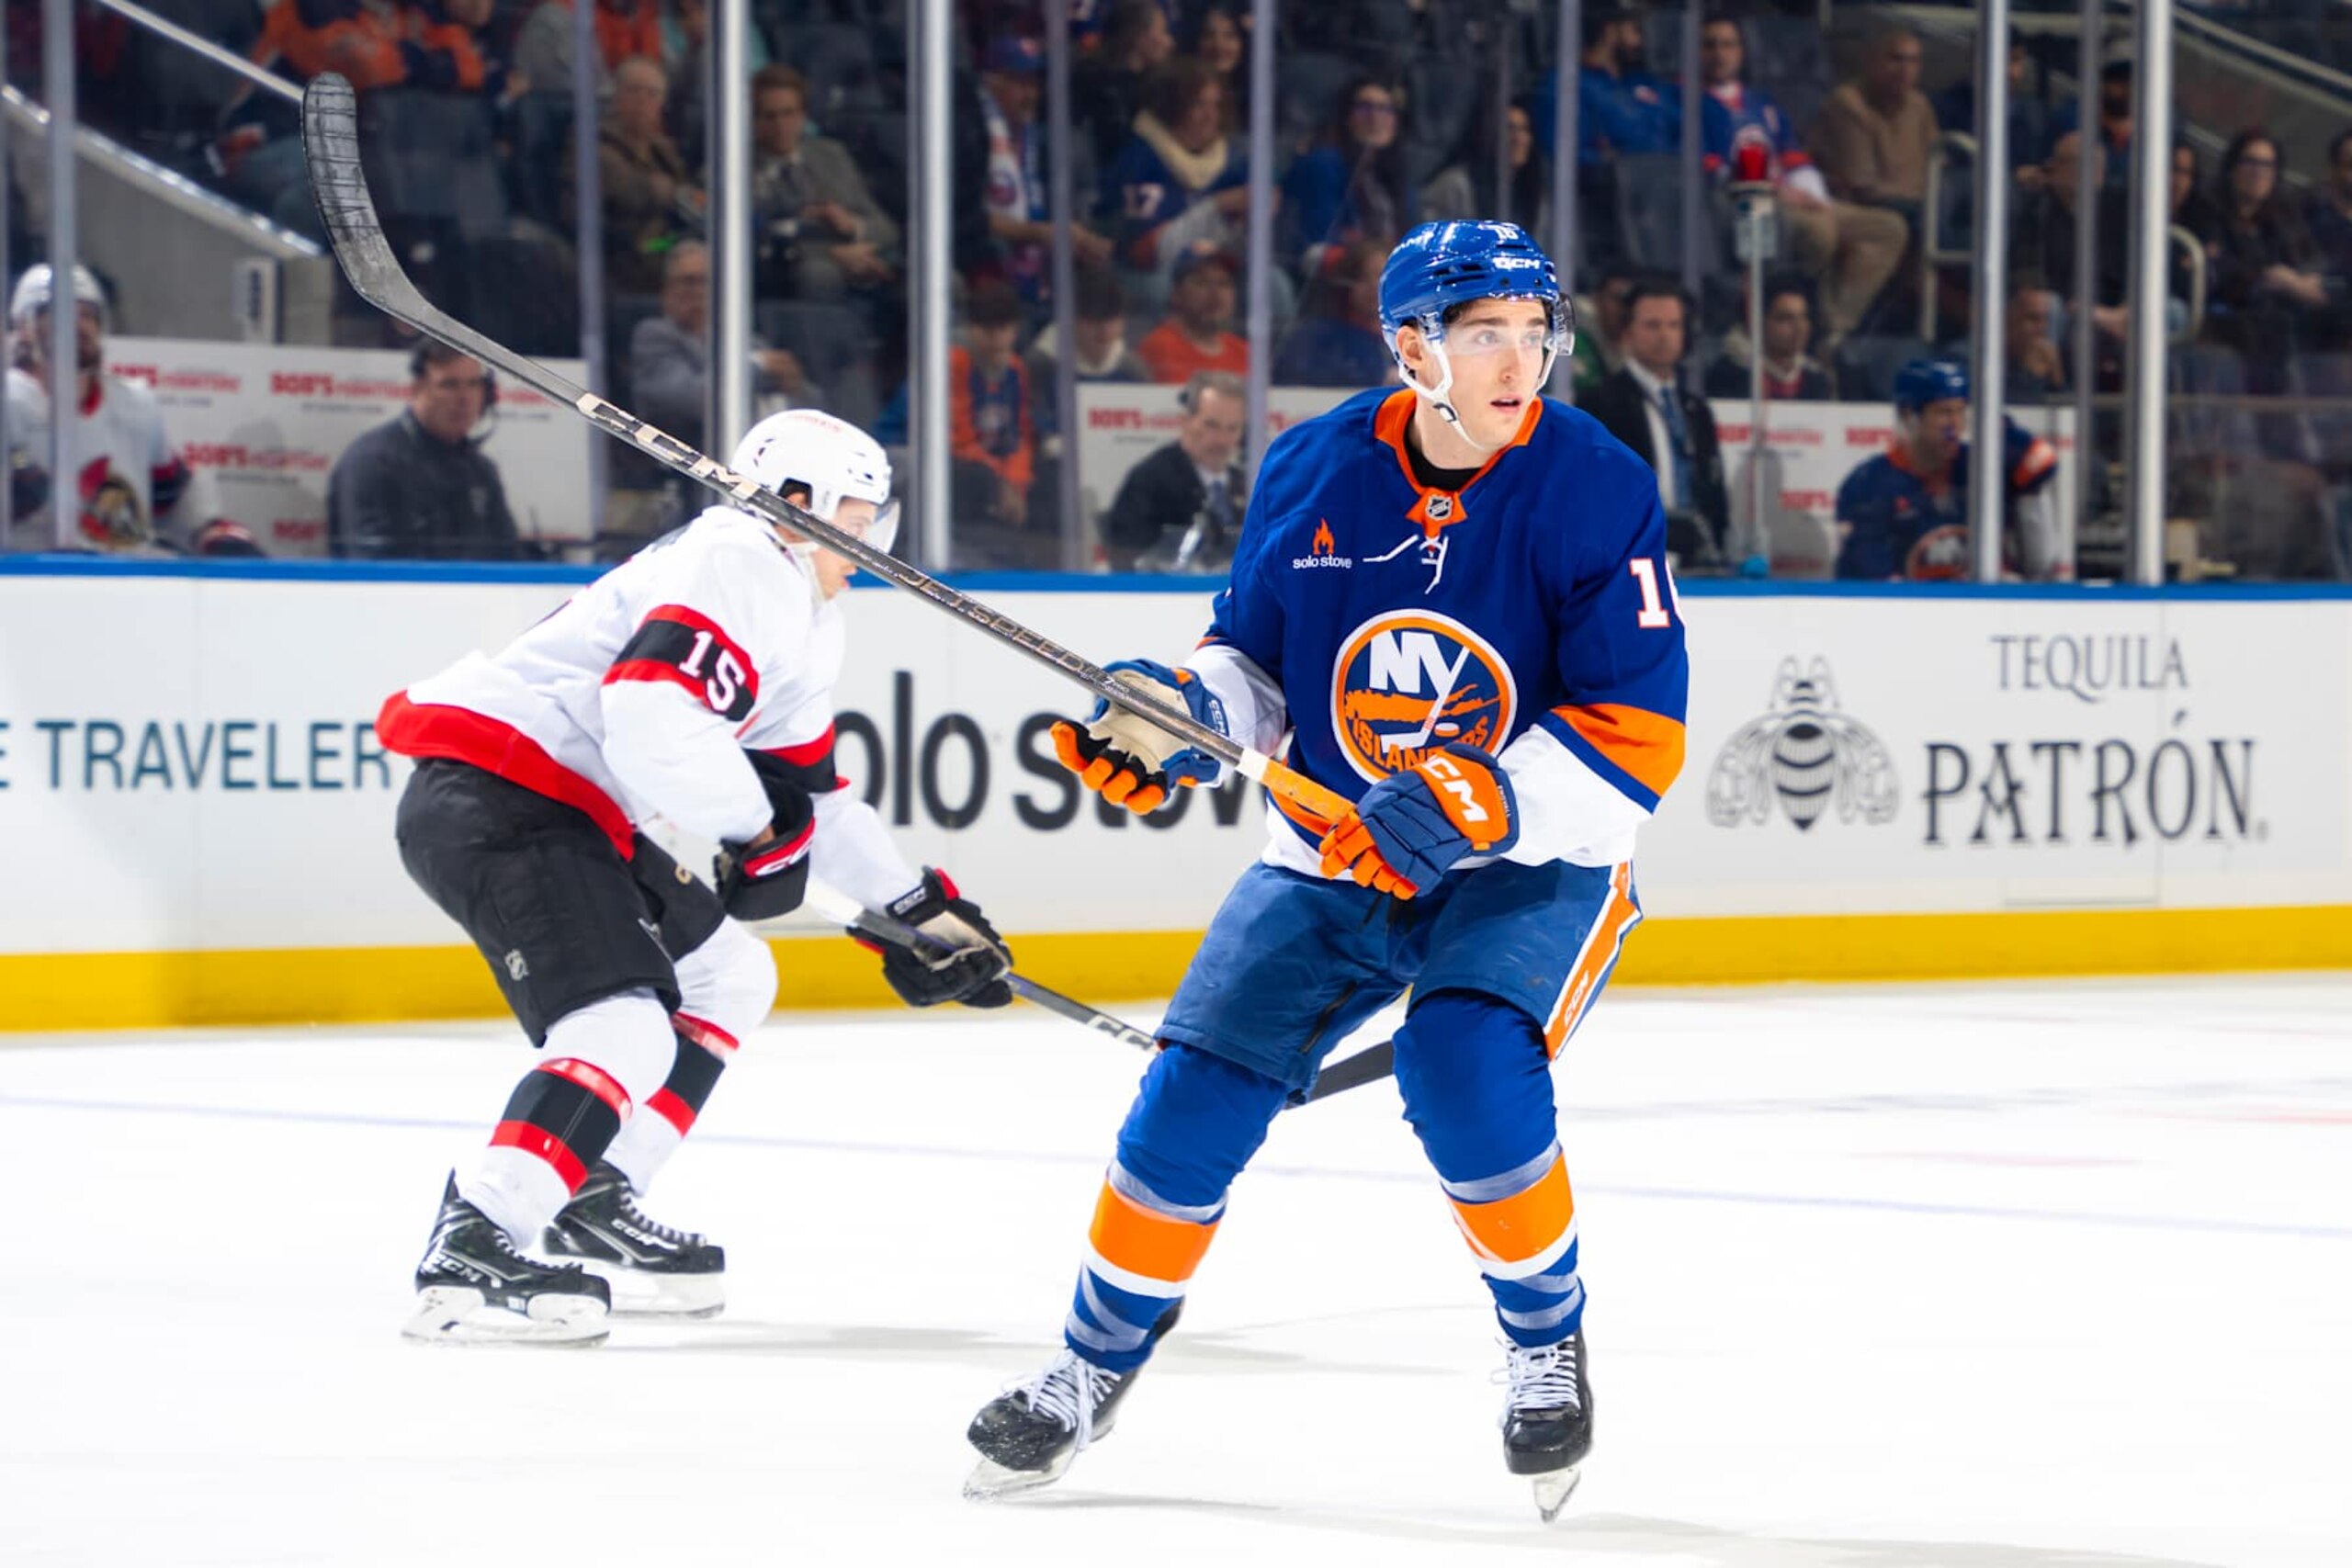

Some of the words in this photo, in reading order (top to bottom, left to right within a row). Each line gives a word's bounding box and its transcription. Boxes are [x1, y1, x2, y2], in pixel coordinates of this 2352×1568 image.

[1293, 555, 1319, 570] solo
[1320, 554, 1352, 570] stove
[1628, 557, 1688, 629] 1
[678, 629, 746, 712] 15
[1989, 634, 2188, 703] TEQUILA
[35, 720, 392, 791] TRAVELER
[1421, 753, 1488, 822] CM
[1921, 708, 2254, 847] PATRÓN
